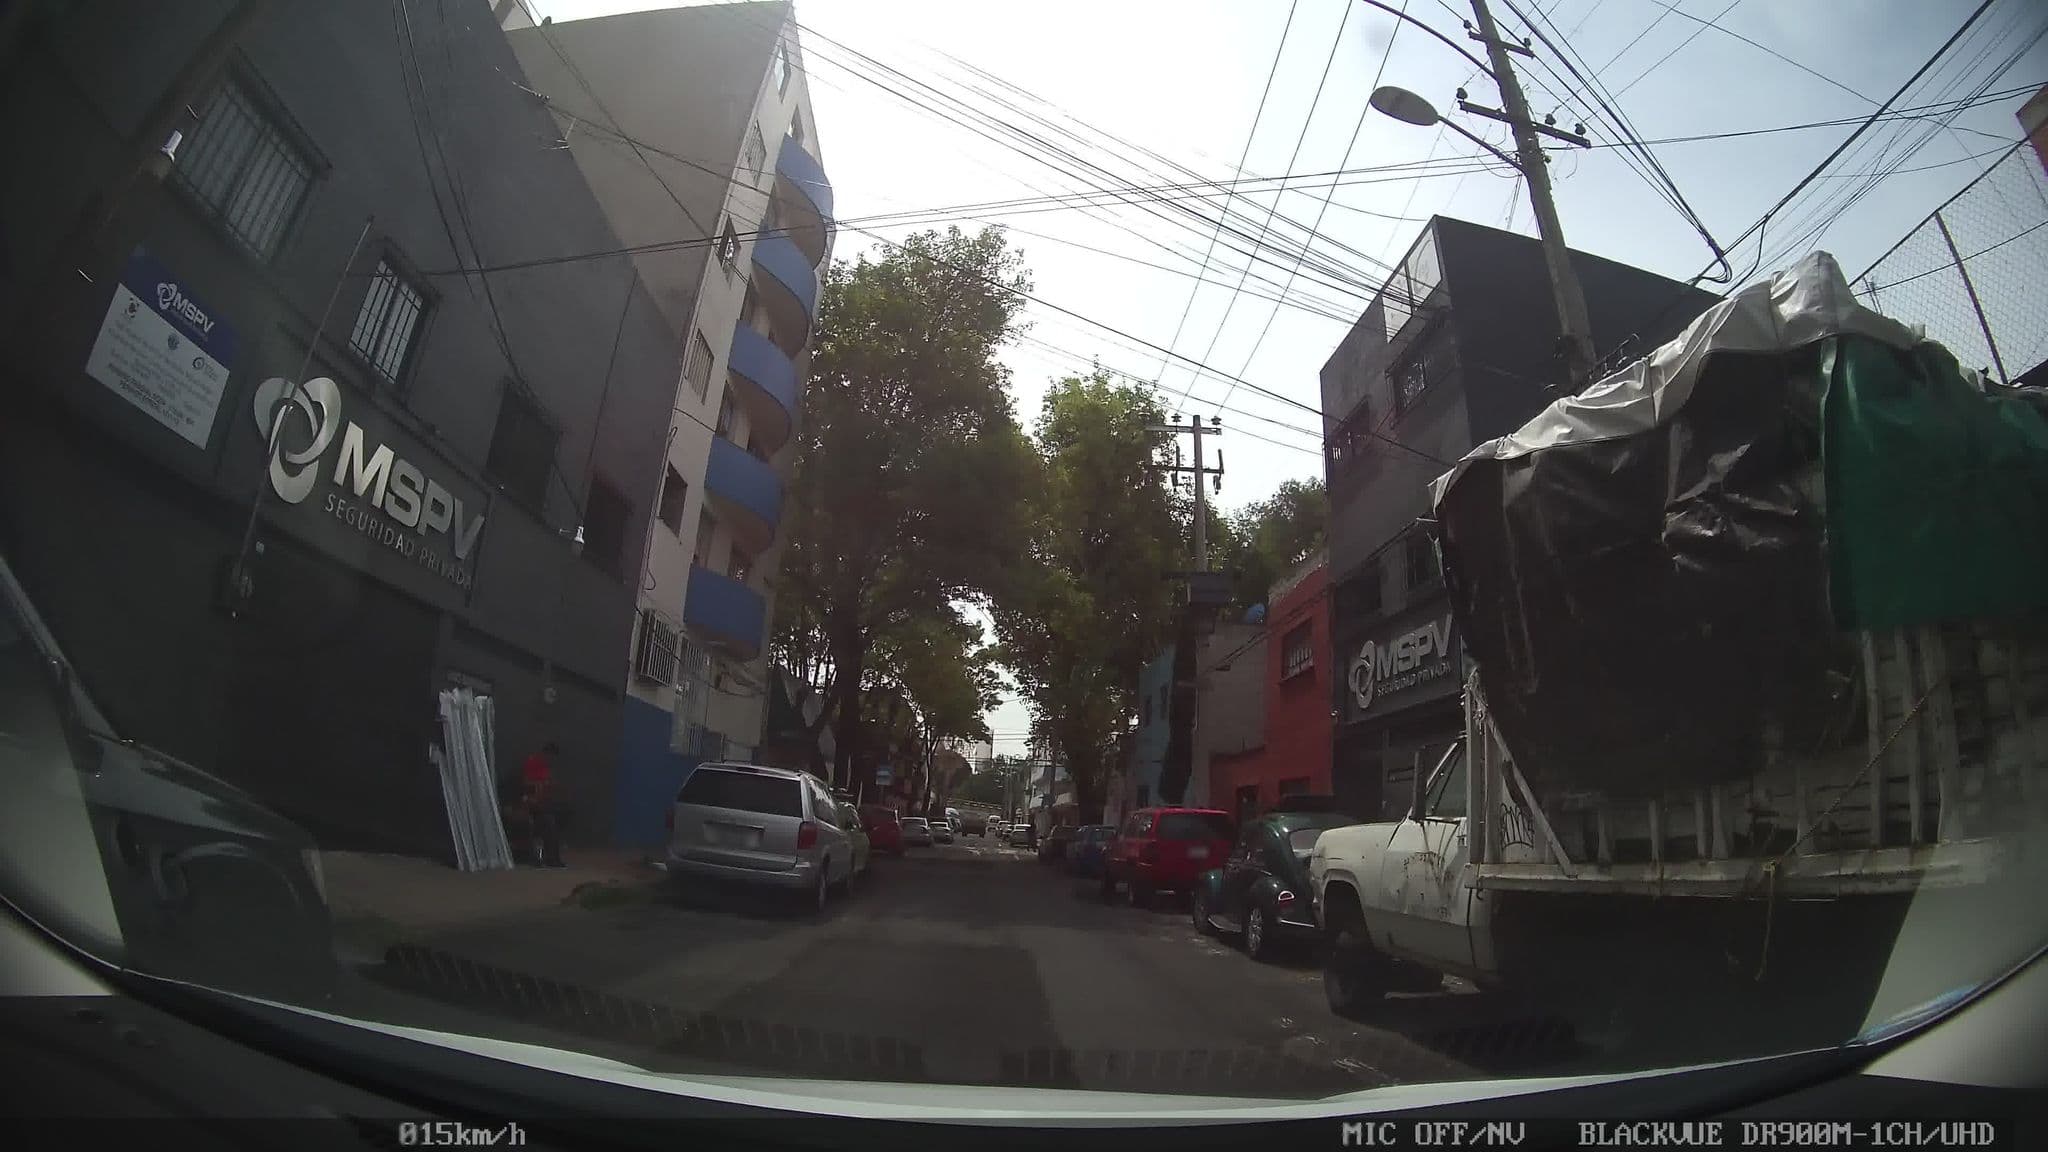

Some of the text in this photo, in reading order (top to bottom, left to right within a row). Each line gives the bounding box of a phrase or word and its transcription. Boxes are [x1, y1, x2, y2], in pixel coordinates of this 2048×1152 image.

[173, 292, 215, 333] MSPV
[333, 420, 485, 560] MSPV
[325, 494, 472, 590] SEGURIDAD PRIVADA
[1376, 613, 1452, 681] MSPV
